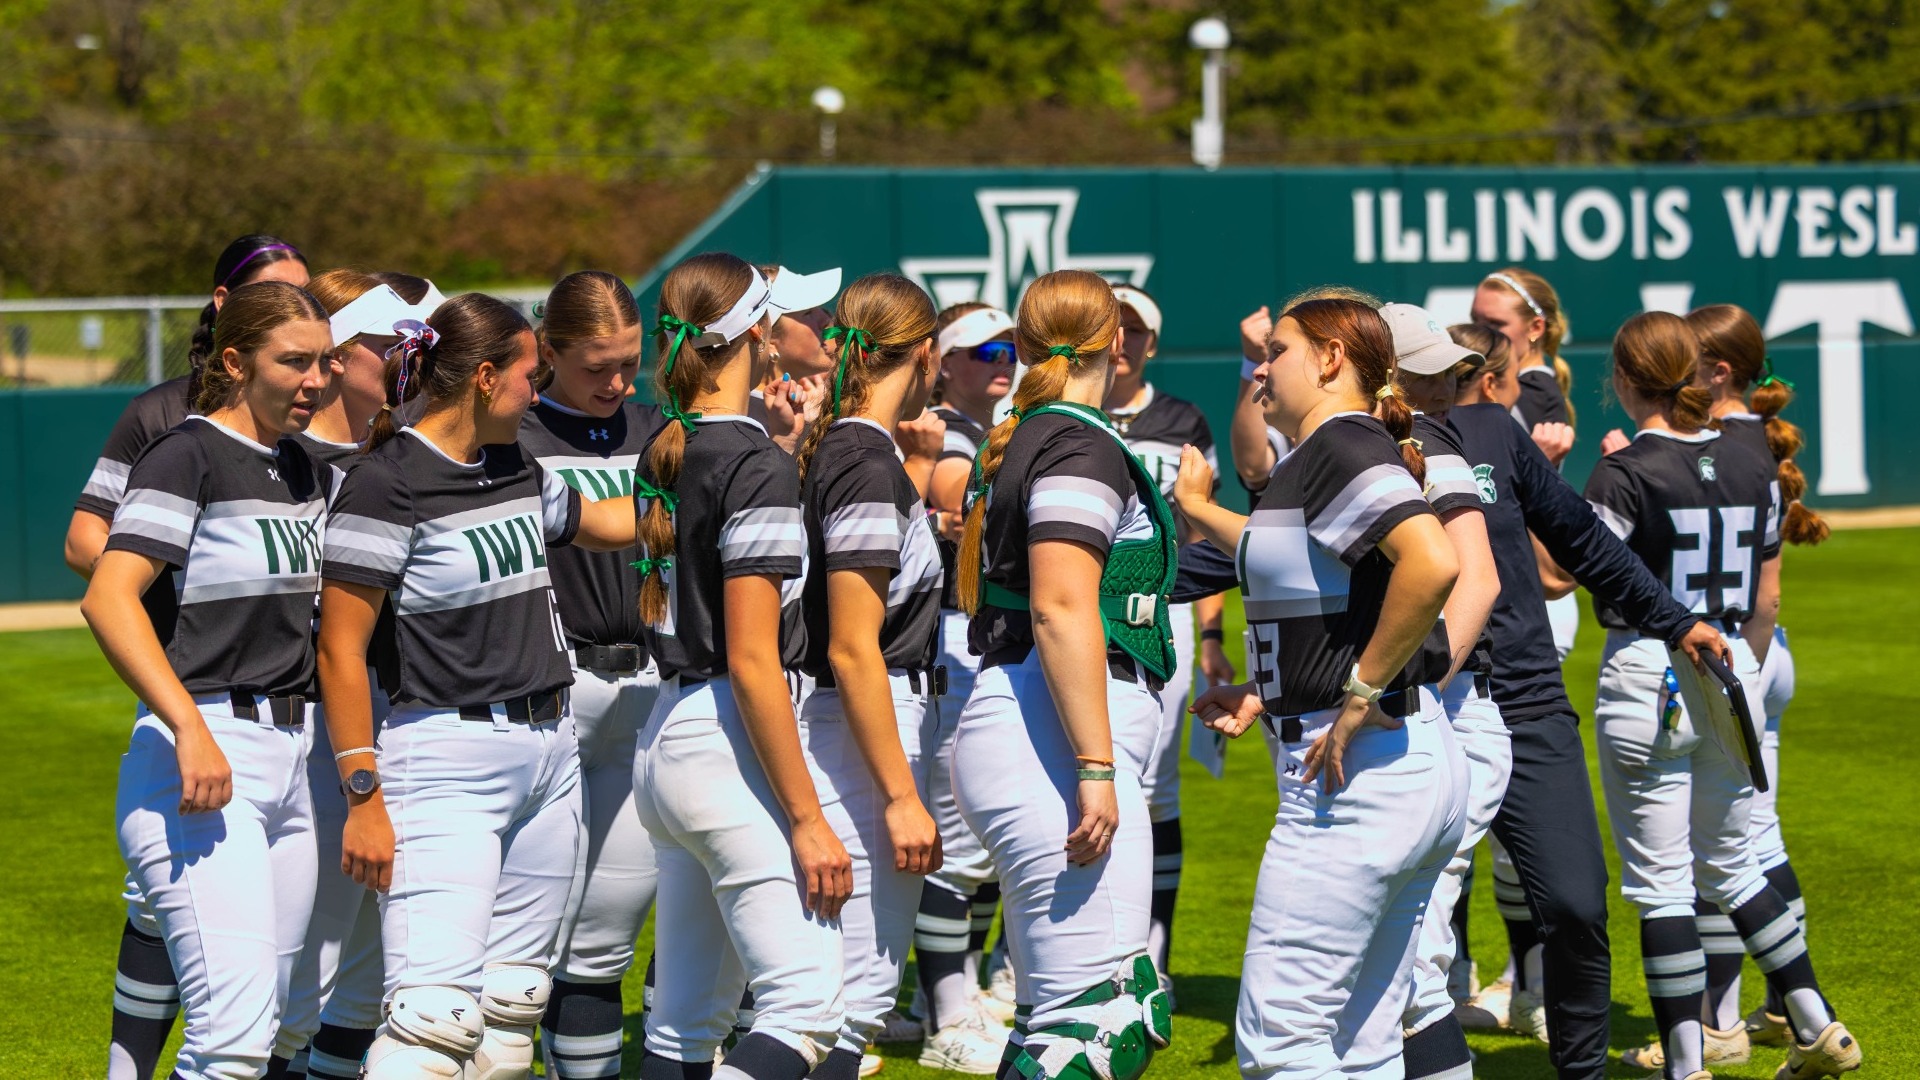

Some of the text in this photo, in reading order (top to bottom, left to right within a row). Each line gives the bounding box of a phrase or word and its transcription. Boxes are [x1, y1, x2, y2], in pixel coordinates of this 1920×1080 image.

[1352, 185, 1917, 263] ILLINOIS WESL
[254, 518, 322, 574] IWU
[1667, 506, 1755, 614] 25
